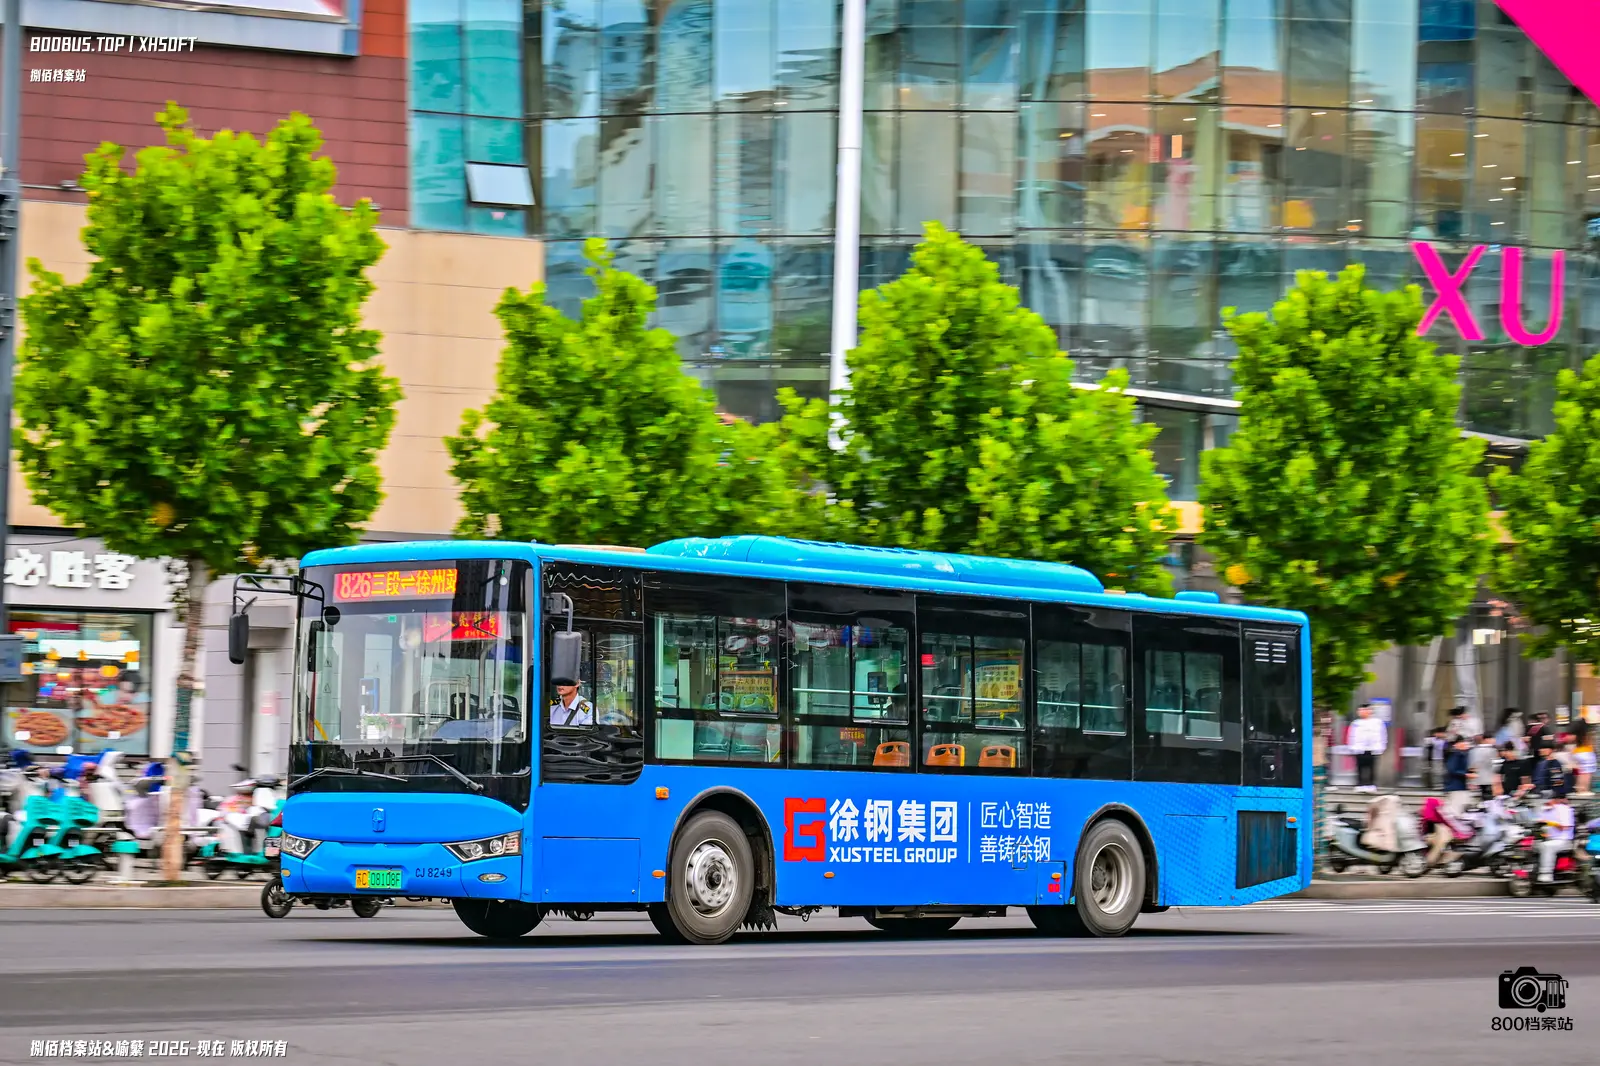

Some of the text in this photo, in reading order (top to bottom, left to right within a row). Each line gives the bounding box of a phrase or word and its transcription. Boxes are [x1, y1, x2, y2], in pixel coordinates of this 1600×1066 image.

[1411, 241, 1566, 346] XU
[3, 548, 137, 589] 必胜客
[829, 798, 958, 843] 徐钢集团
[980, 801, 1052, 830] 匠心智造
[829, 847, 958, 864] XUSTEEL GROUP
[979, 835, 1051, 864] 善铸徐钢
